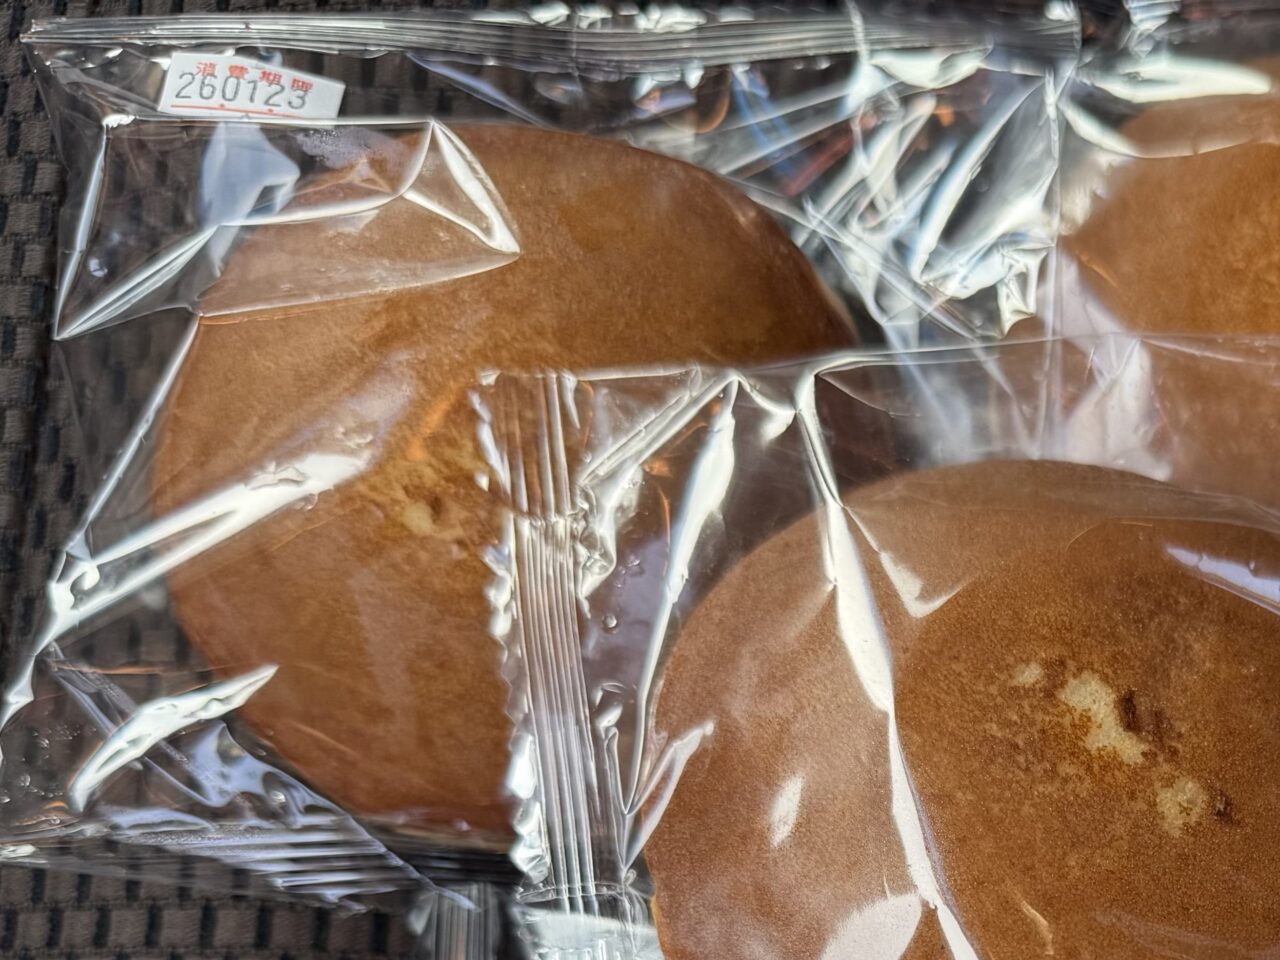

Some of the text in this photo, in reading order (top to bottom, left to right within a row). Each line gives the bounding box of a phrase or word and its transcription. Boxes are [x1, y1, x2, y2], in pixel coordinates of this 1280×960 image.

[175, 72, 307, 110] 260123
[195, 61, 314, 95] 消費期限
